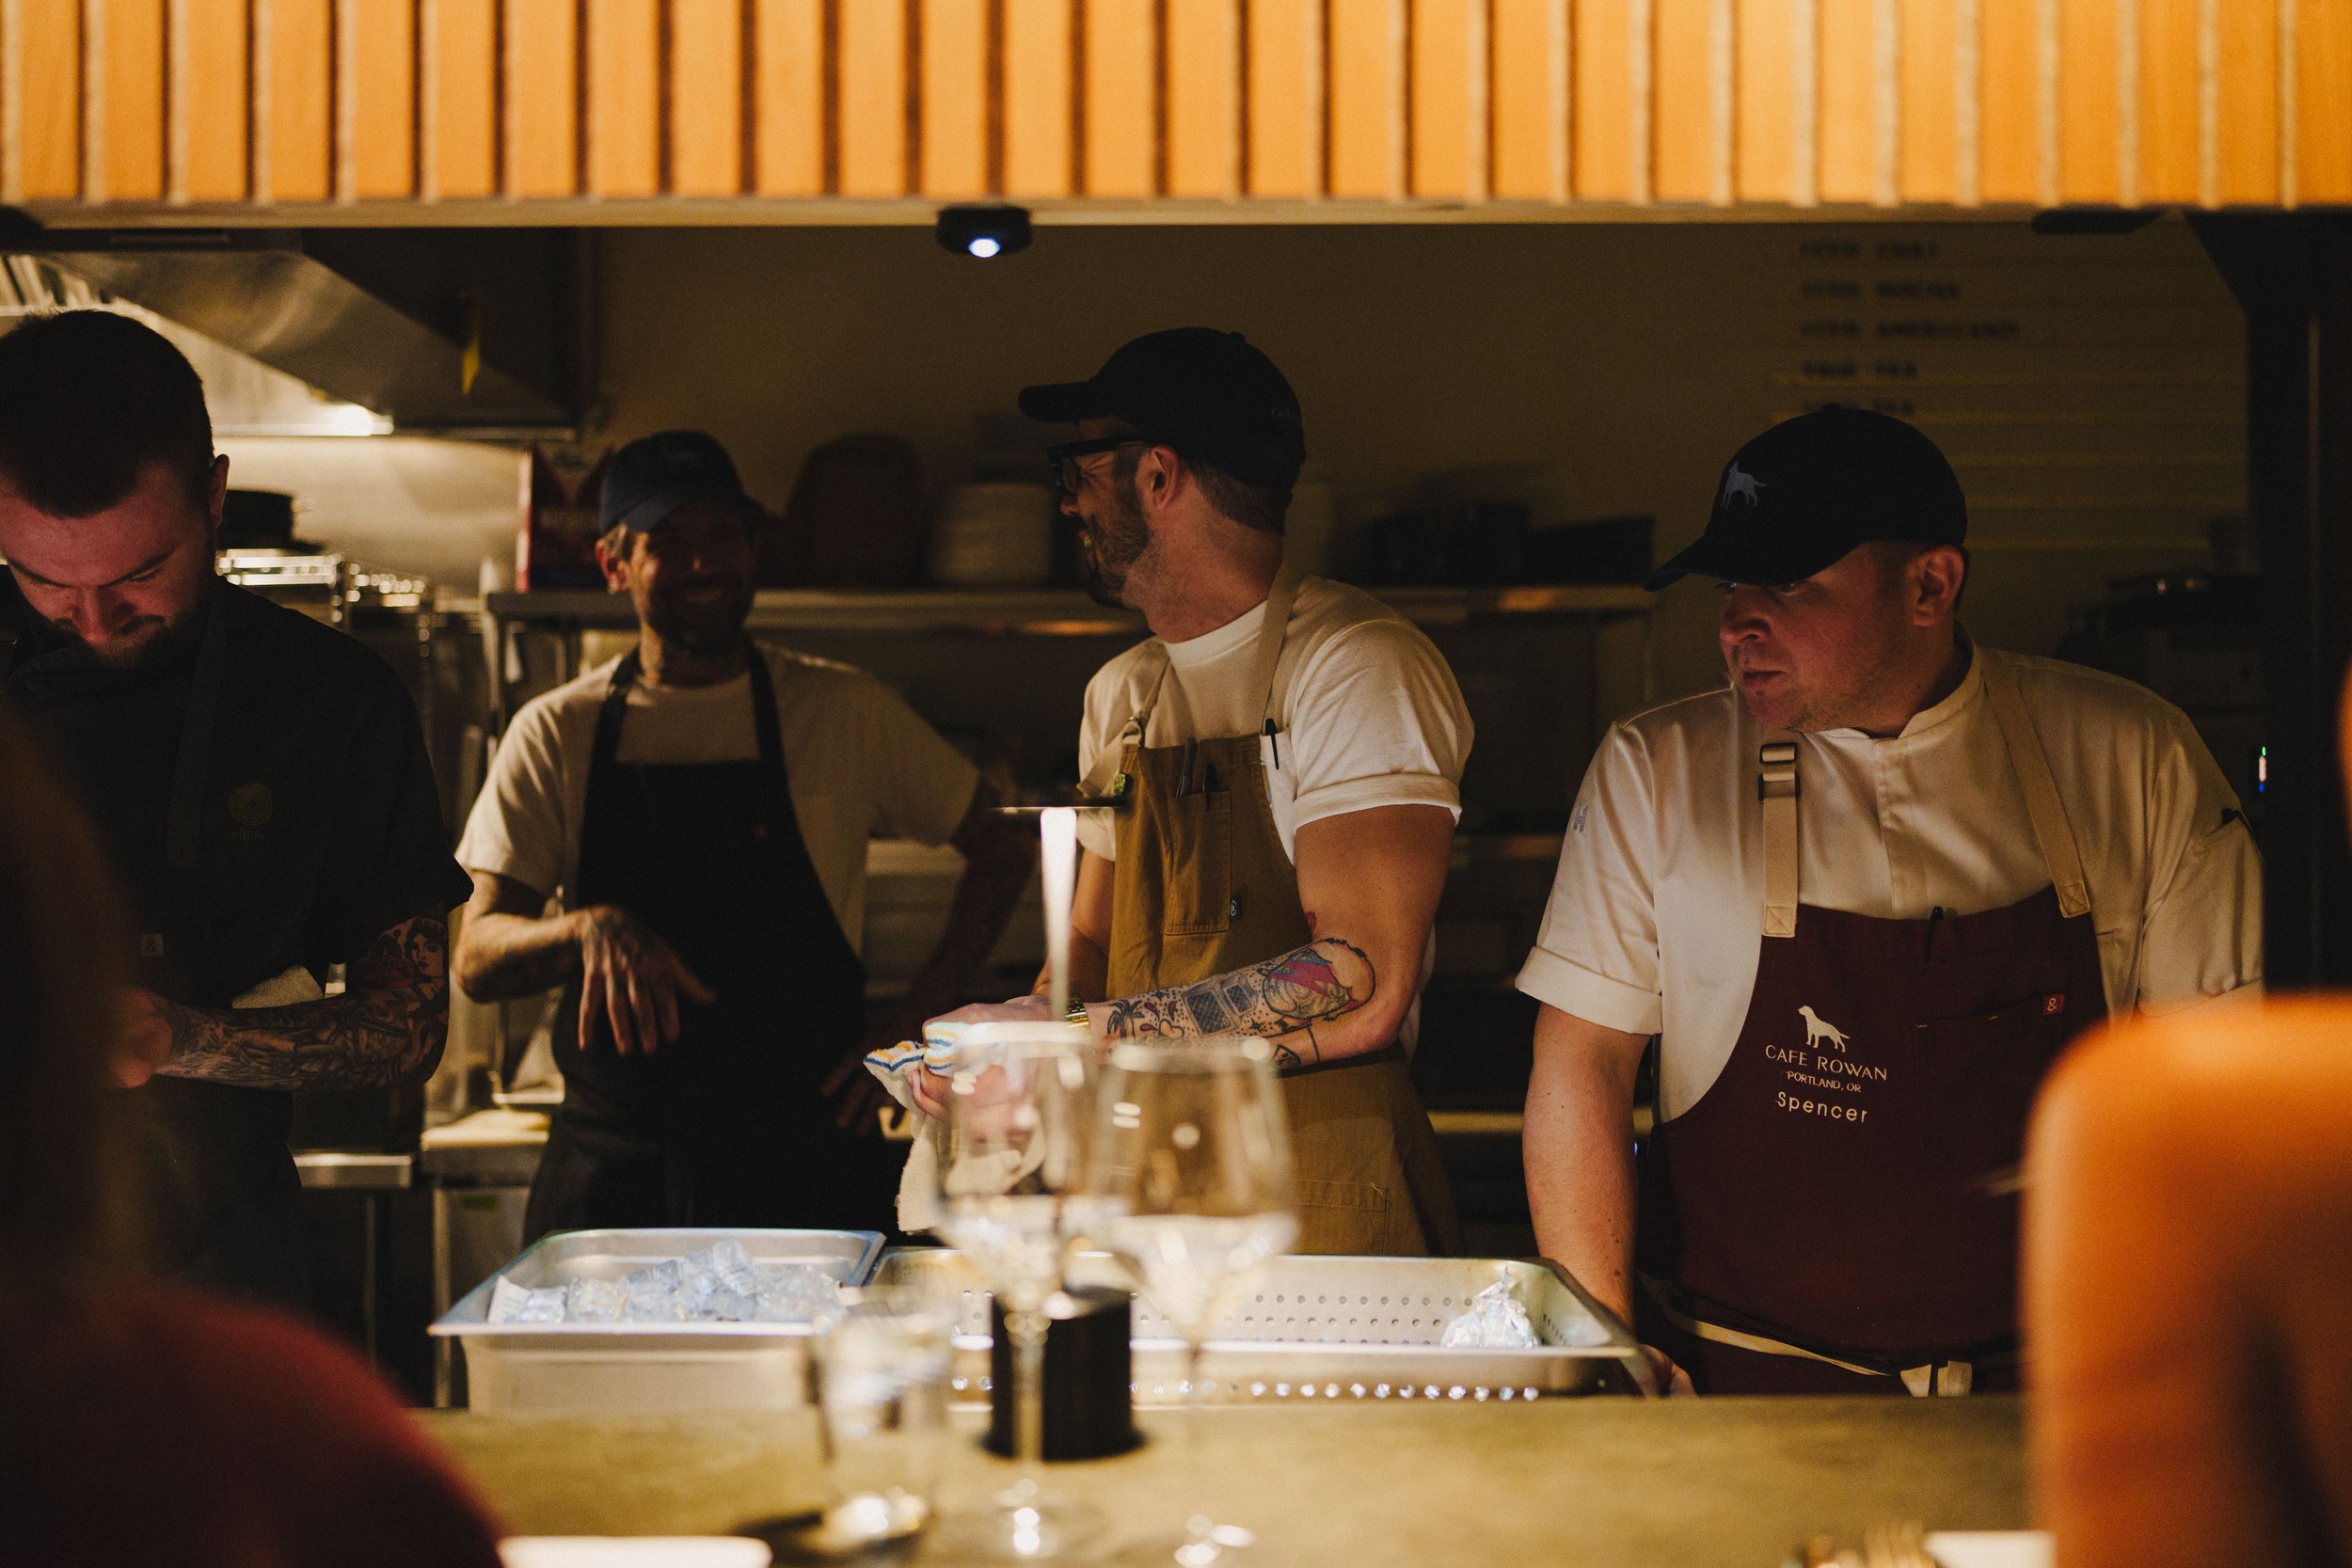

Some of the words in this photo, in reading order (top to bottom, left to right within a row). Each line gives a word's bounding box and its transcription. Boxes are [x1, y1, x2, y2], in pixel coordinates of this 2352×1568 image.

[1765, 1044, 1808, 1067] CAFE
[1817, 1055, 1888, 1082] ROWAN
[1788, 1070, 1845, 1091] PORTLAND,
[1847, 1083, 1862, 1093] OR
[1776, 1091, 1867, 1123] Spencer
